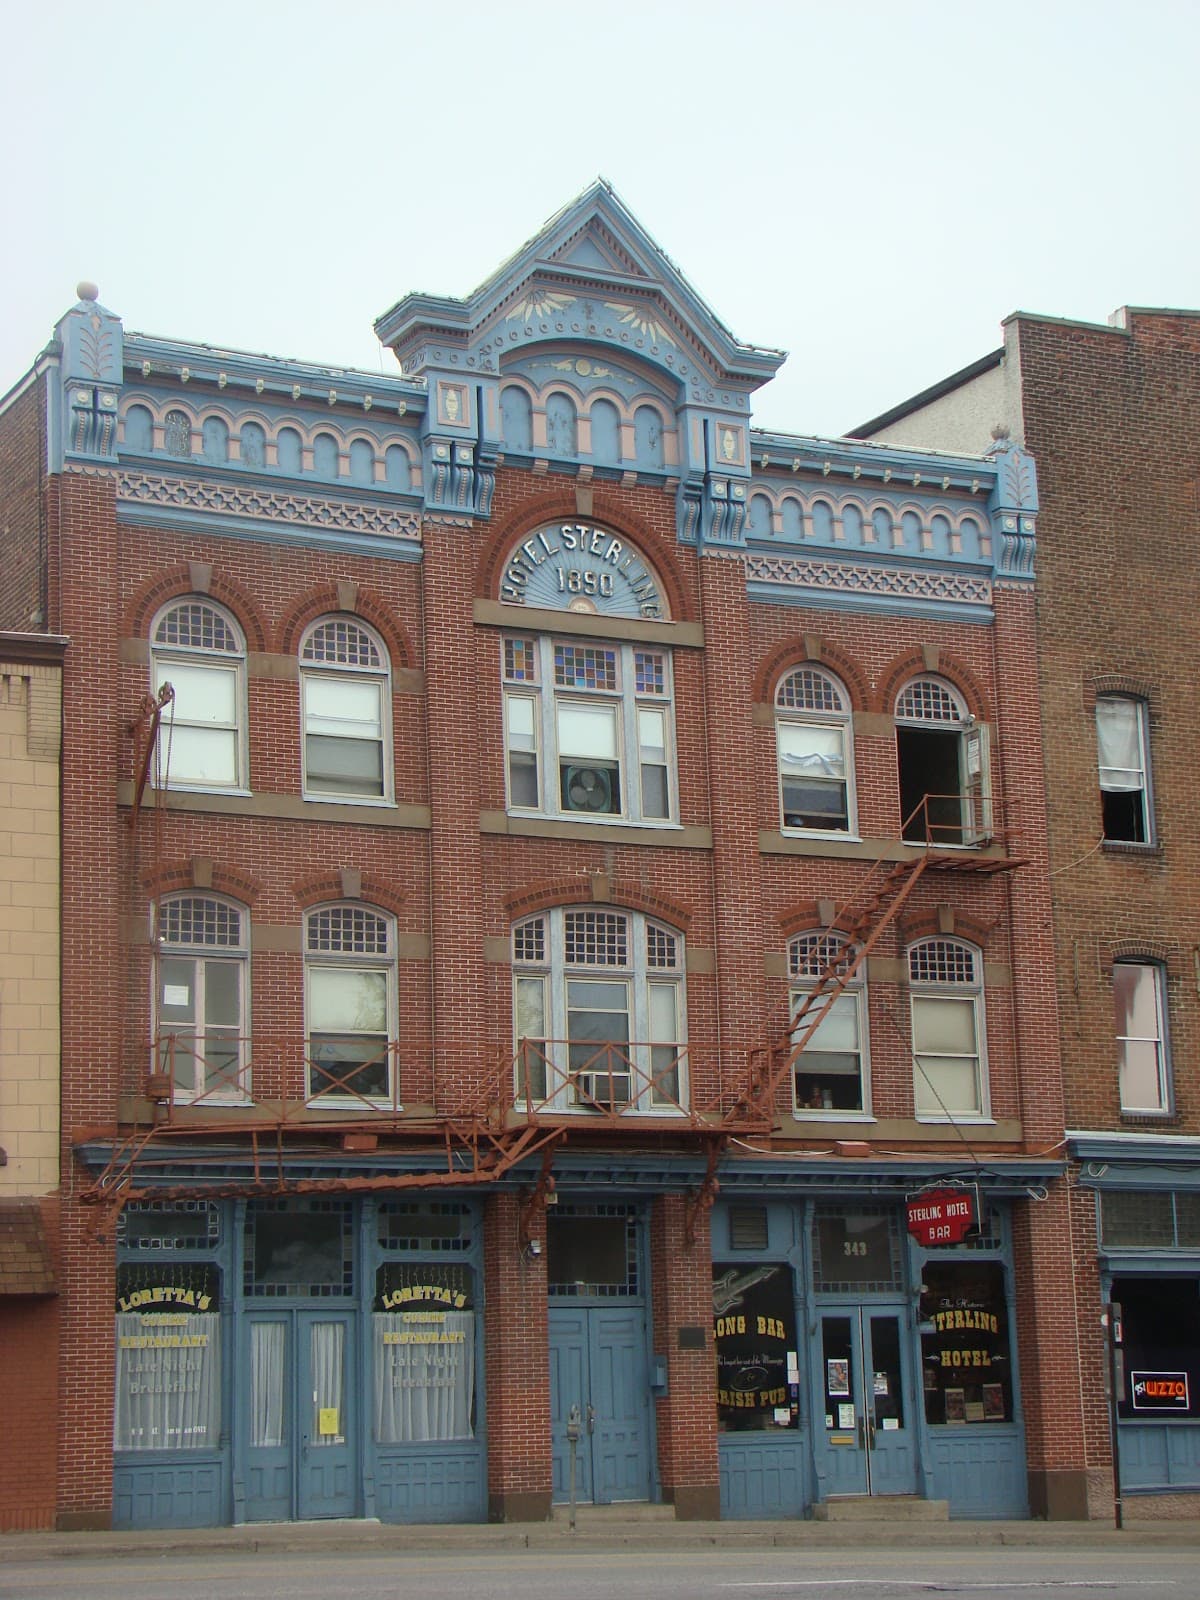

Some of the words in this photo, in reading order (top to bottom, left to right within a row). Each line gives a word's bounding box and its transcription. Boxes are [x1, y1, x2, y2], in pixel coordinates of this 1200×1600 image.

[501, 532, 560, 604] HOTEL
[560, 524, 662, 618] STERLING
[555, 566, 614, 598] 1890
[908, 1206, 942, 1223] STERLING
[946, 1202, 969, 1217] HOTEL
[929, 1225, 951, 1240] BAR
[843, 1241, 867, 1257] 343
[118, 1287, 212, 1312] LORETTA'S
[381, 1285, 467, 1310] LORETTA'S
[383, 1331, 466, 1345] RESTAURANT
[757, 1315, 786, 1340] BAR
[119, 1334, 209, 1349] RESTAURANT
[941, 1350, 992, 1367] HOTEL
[717, 1389, 756, 1408] RISH
[759, 1386, 786, 1408] PUB
